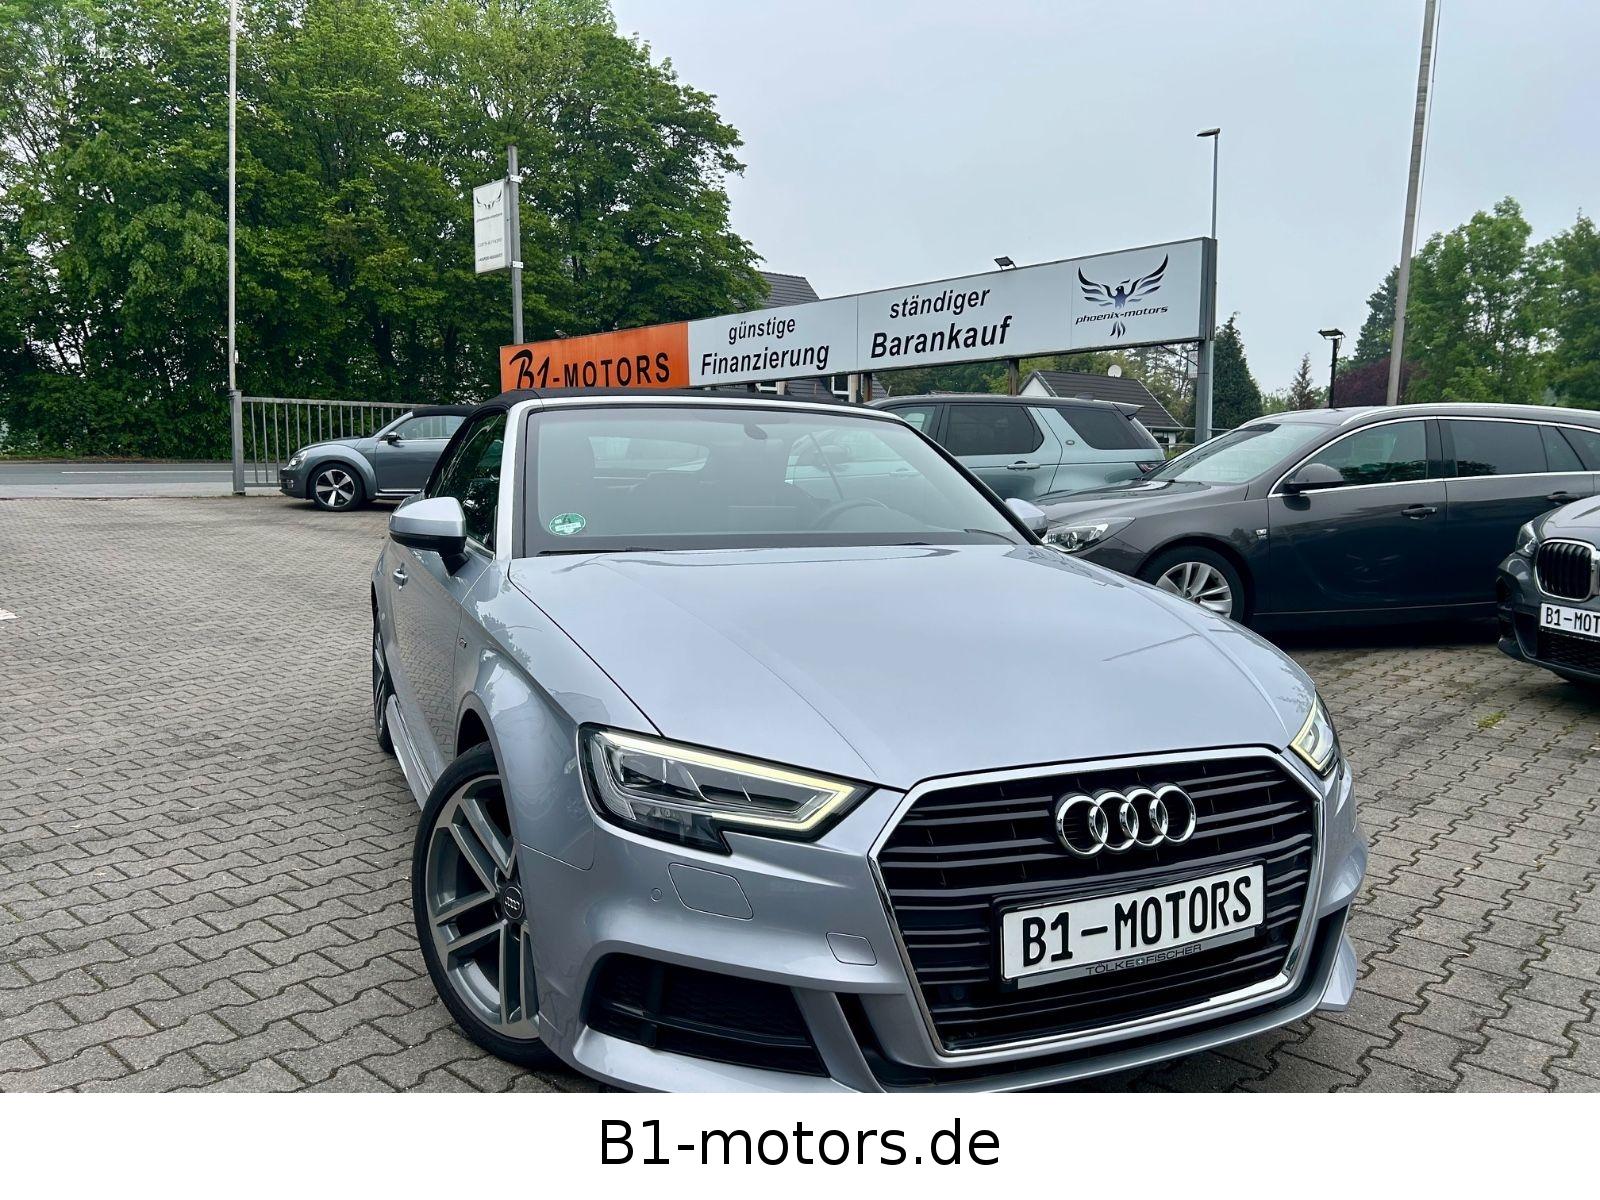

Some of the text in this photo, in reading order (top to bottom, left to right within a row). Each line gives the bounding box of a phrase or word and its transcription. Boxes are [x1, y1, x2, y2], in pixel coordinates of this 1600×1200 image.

[889, 288, 990, 319] ständiger
[1075, 306, 1169, 325] phoenix-motors
[728, 316, 796, 345] günstige
[870, 315, 1013, 359] Barankauf
[700, 344, 830, 376] Finanzierung
[1023, 876, 1251, 967] B1-MOTORS
